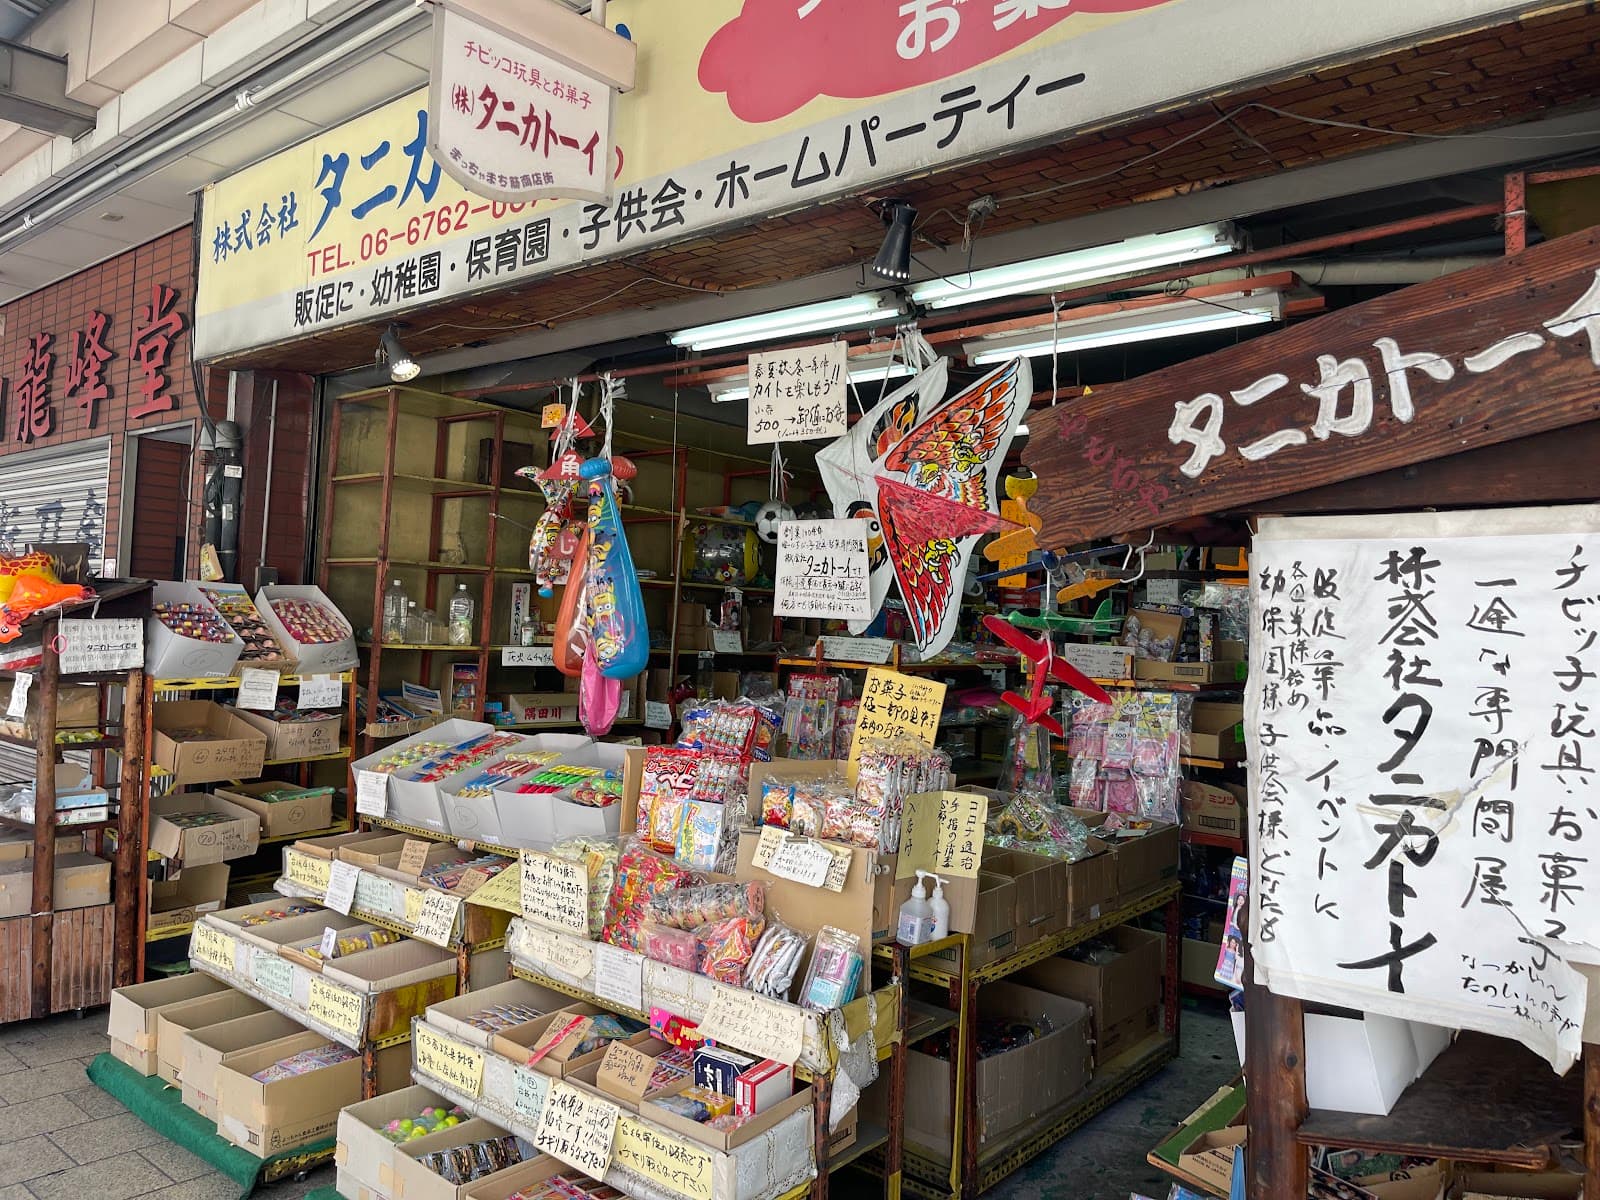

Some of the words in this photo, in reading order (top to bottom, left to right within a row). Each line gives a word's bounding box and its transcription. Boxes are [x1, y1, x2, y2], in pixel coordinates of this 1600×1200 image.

[463, 40, 592, 110] チビッコ玩具とお菓子
[211, 190, 299, 265] 株式会社
[308, 109, 442, 244] タニカ
[450, 148, 554, 190] まっちゃまち筋商店街
[0, 284, 184, 443] 龍峰堂
[1168, 268, 1600, 479] タニカトーイ
[754, 419, 780, 434] 500
[869, 676, 907, 701] お菓子
[960, 801, 979, 870] コロナ退治
